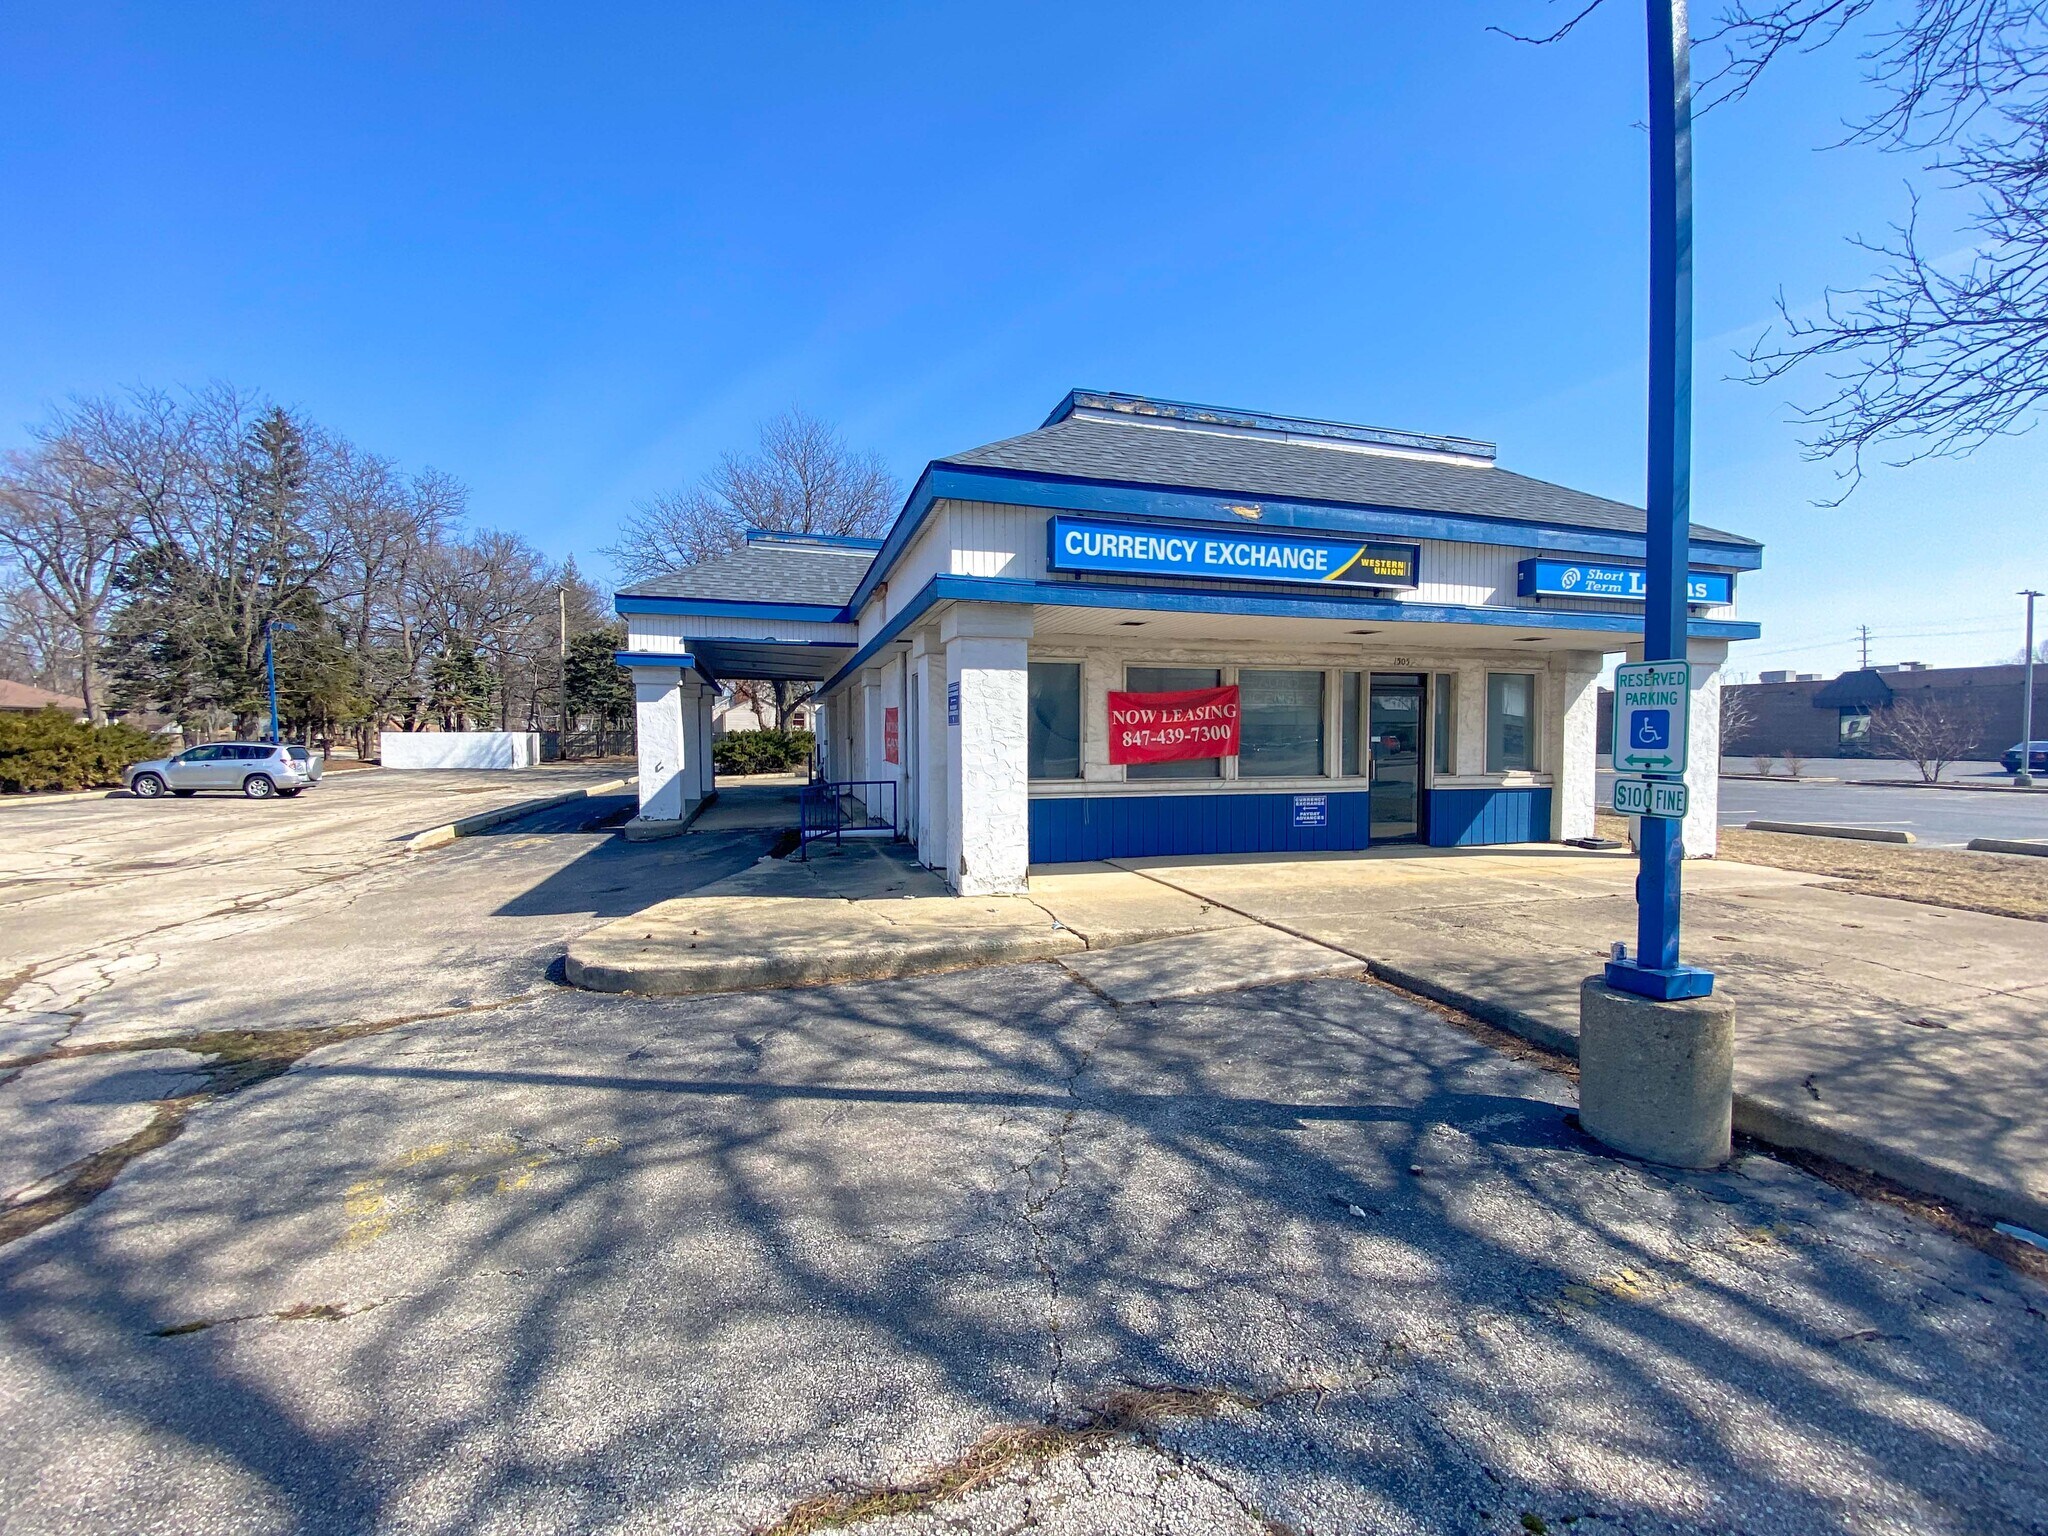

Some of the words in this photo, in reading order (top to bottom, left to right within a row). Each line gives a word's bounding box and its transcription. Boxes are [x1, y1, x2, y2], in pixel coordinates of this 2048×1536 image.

[1065, 530, 1198, 563] CURRENCY
[1204, 542, 1328, 571] EXCHANGE
[1360, 558, 1404, 569] WESTERN
[1374, 567, 1404, 576] UNION
[1587, 569, 1623, 581] Short
[1585, 581, 1622, 592] Term
[1620, 671, 1686, 688] RESERVED
[1625, 691, 1678, 706] PARKING
[1112, 709, 1157, 725] NOW
[1161, 703, 1237, 723] LEASING
[1122, 724, 1231, 747] 847-439-7300
[1617, 785, 1652, 807] $100
[1656, 790, 1684, 811] FINE
